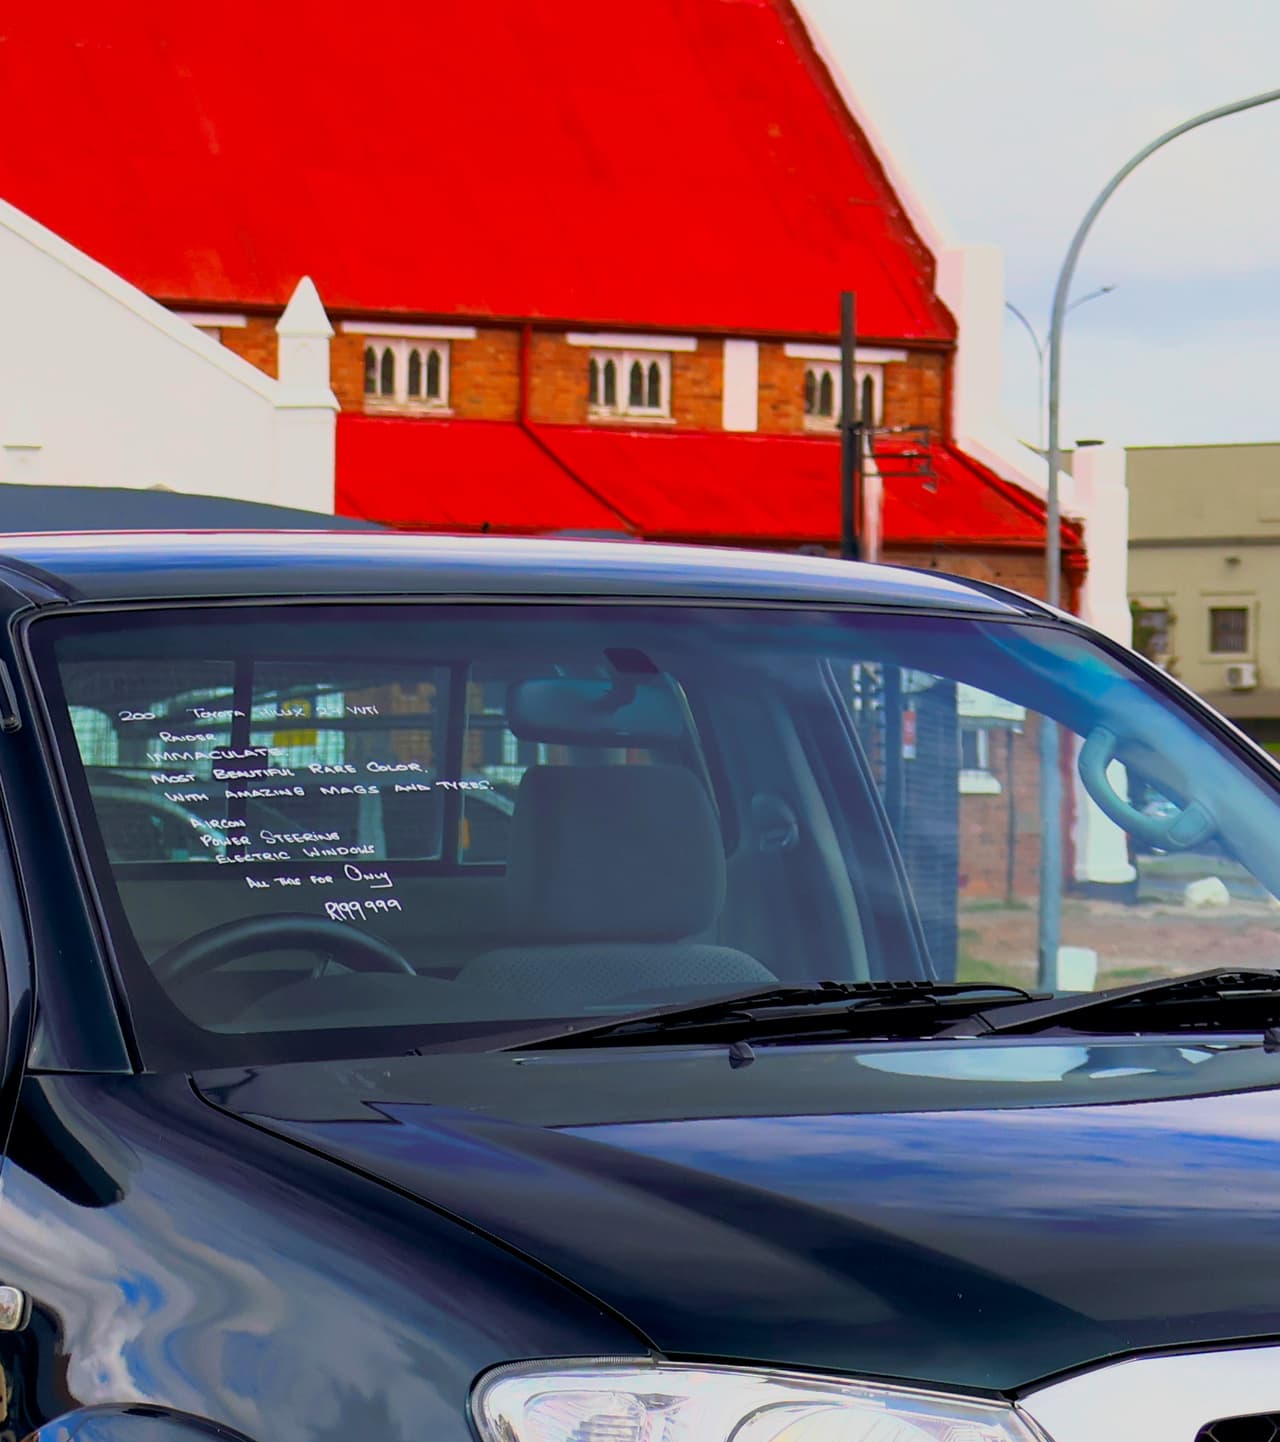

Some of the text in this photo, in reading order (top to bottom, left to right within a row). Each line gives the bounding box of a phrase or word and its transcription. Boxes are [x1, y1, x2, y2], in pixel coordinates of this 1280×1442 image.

[212, 767, 296, 780] BEAUTIFUL
[308, 762, 357, 775] RARE
[319, 784, 381, 796] MAGS
[215, 851, 291, 865] ELECTRIC
